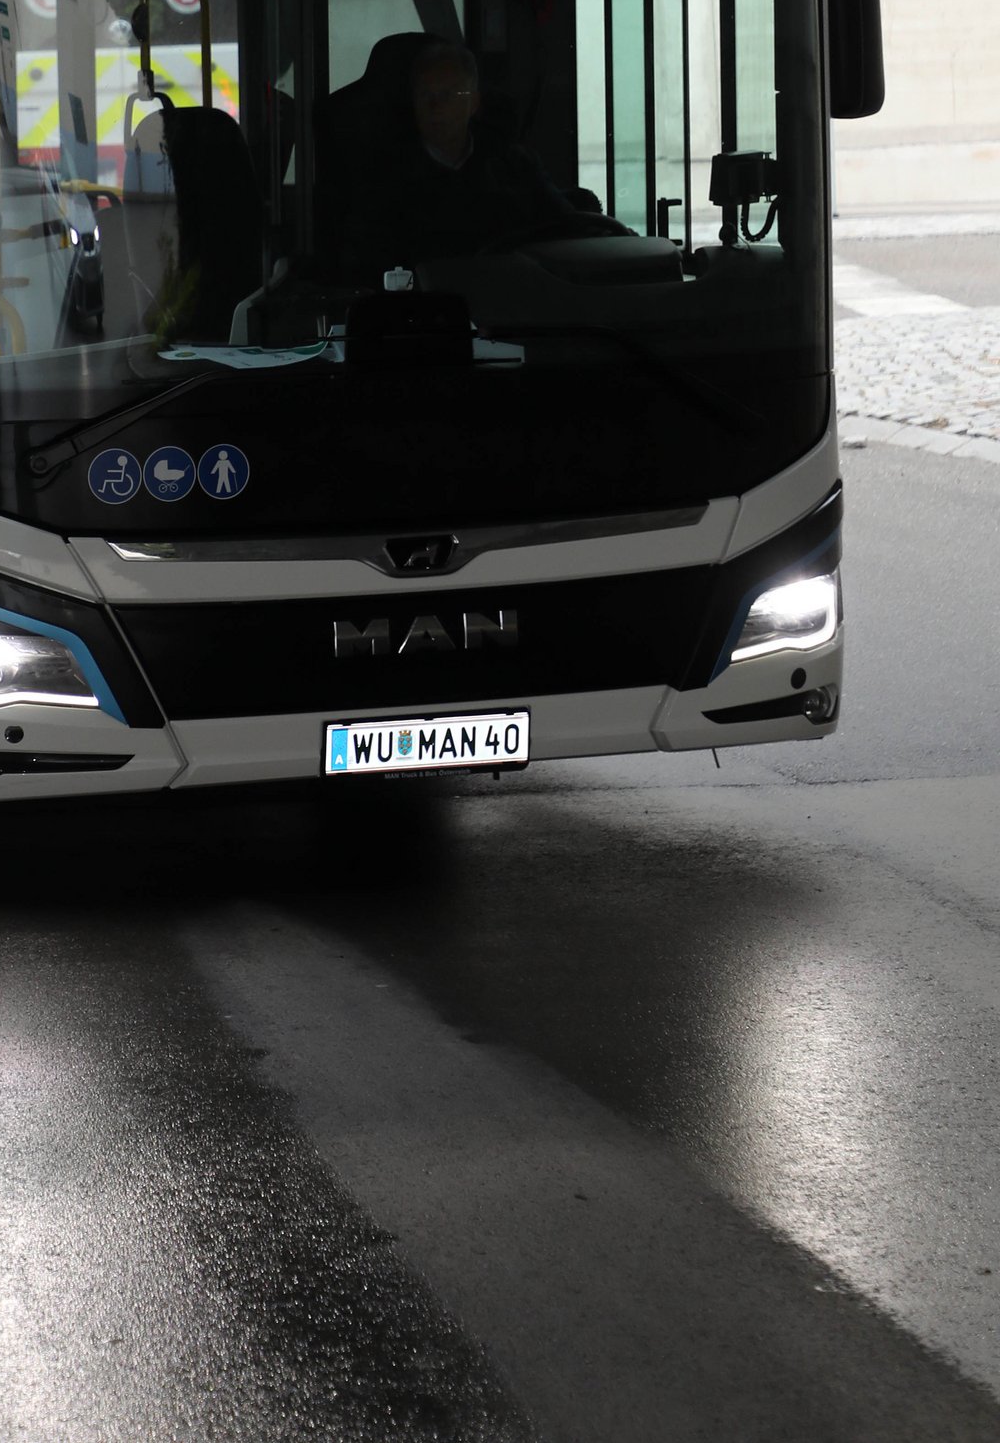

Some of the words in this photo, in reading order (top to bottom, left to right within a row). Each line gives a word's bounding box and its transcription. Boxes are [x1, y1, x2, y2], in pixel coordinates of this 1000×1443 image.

[333, 610, 518, 657] MAN
[335, 754, 343, 764] A
[353, 731, 394, 764] WU
[418, 726, 477, 760] MAN
[485, 723, 520, 756] 40
